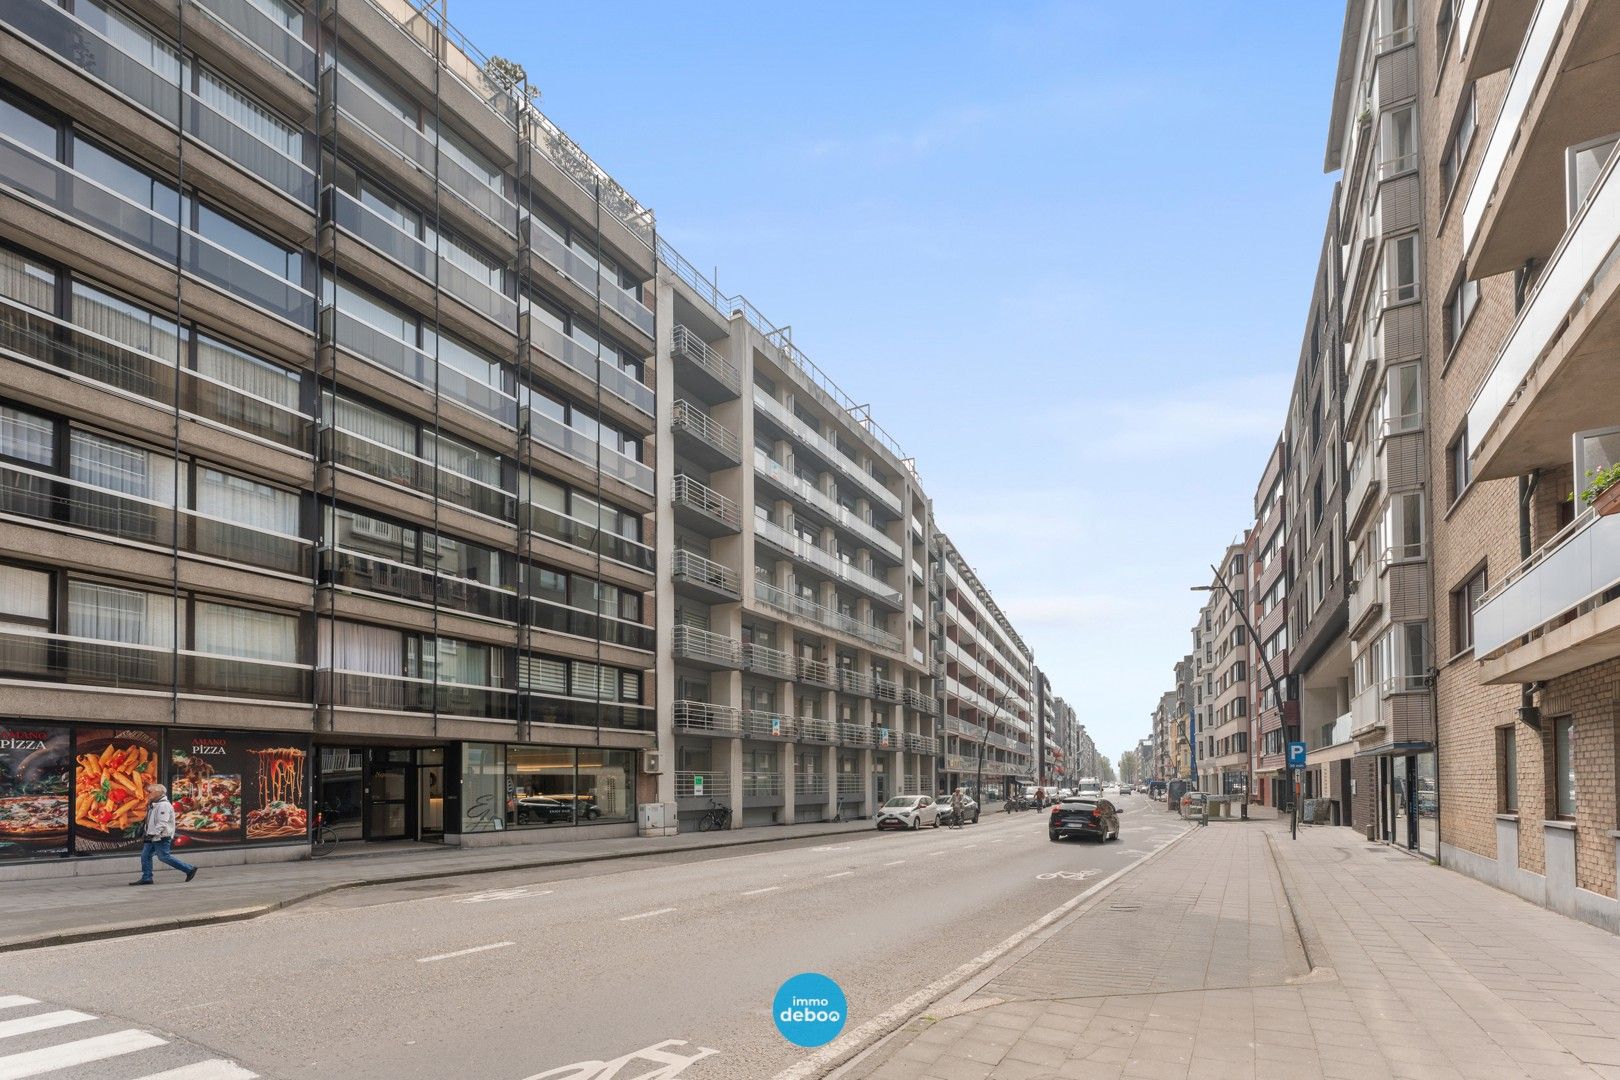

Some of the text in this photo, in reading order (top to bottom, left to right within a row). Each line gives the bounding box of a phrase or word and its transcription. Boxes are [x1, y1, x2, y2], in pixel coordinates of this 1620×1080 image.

[0, 730, 48, 740] AMANO
[192, 738, 226, 746] AMANO
[1290, 745, 1304, 760] P
